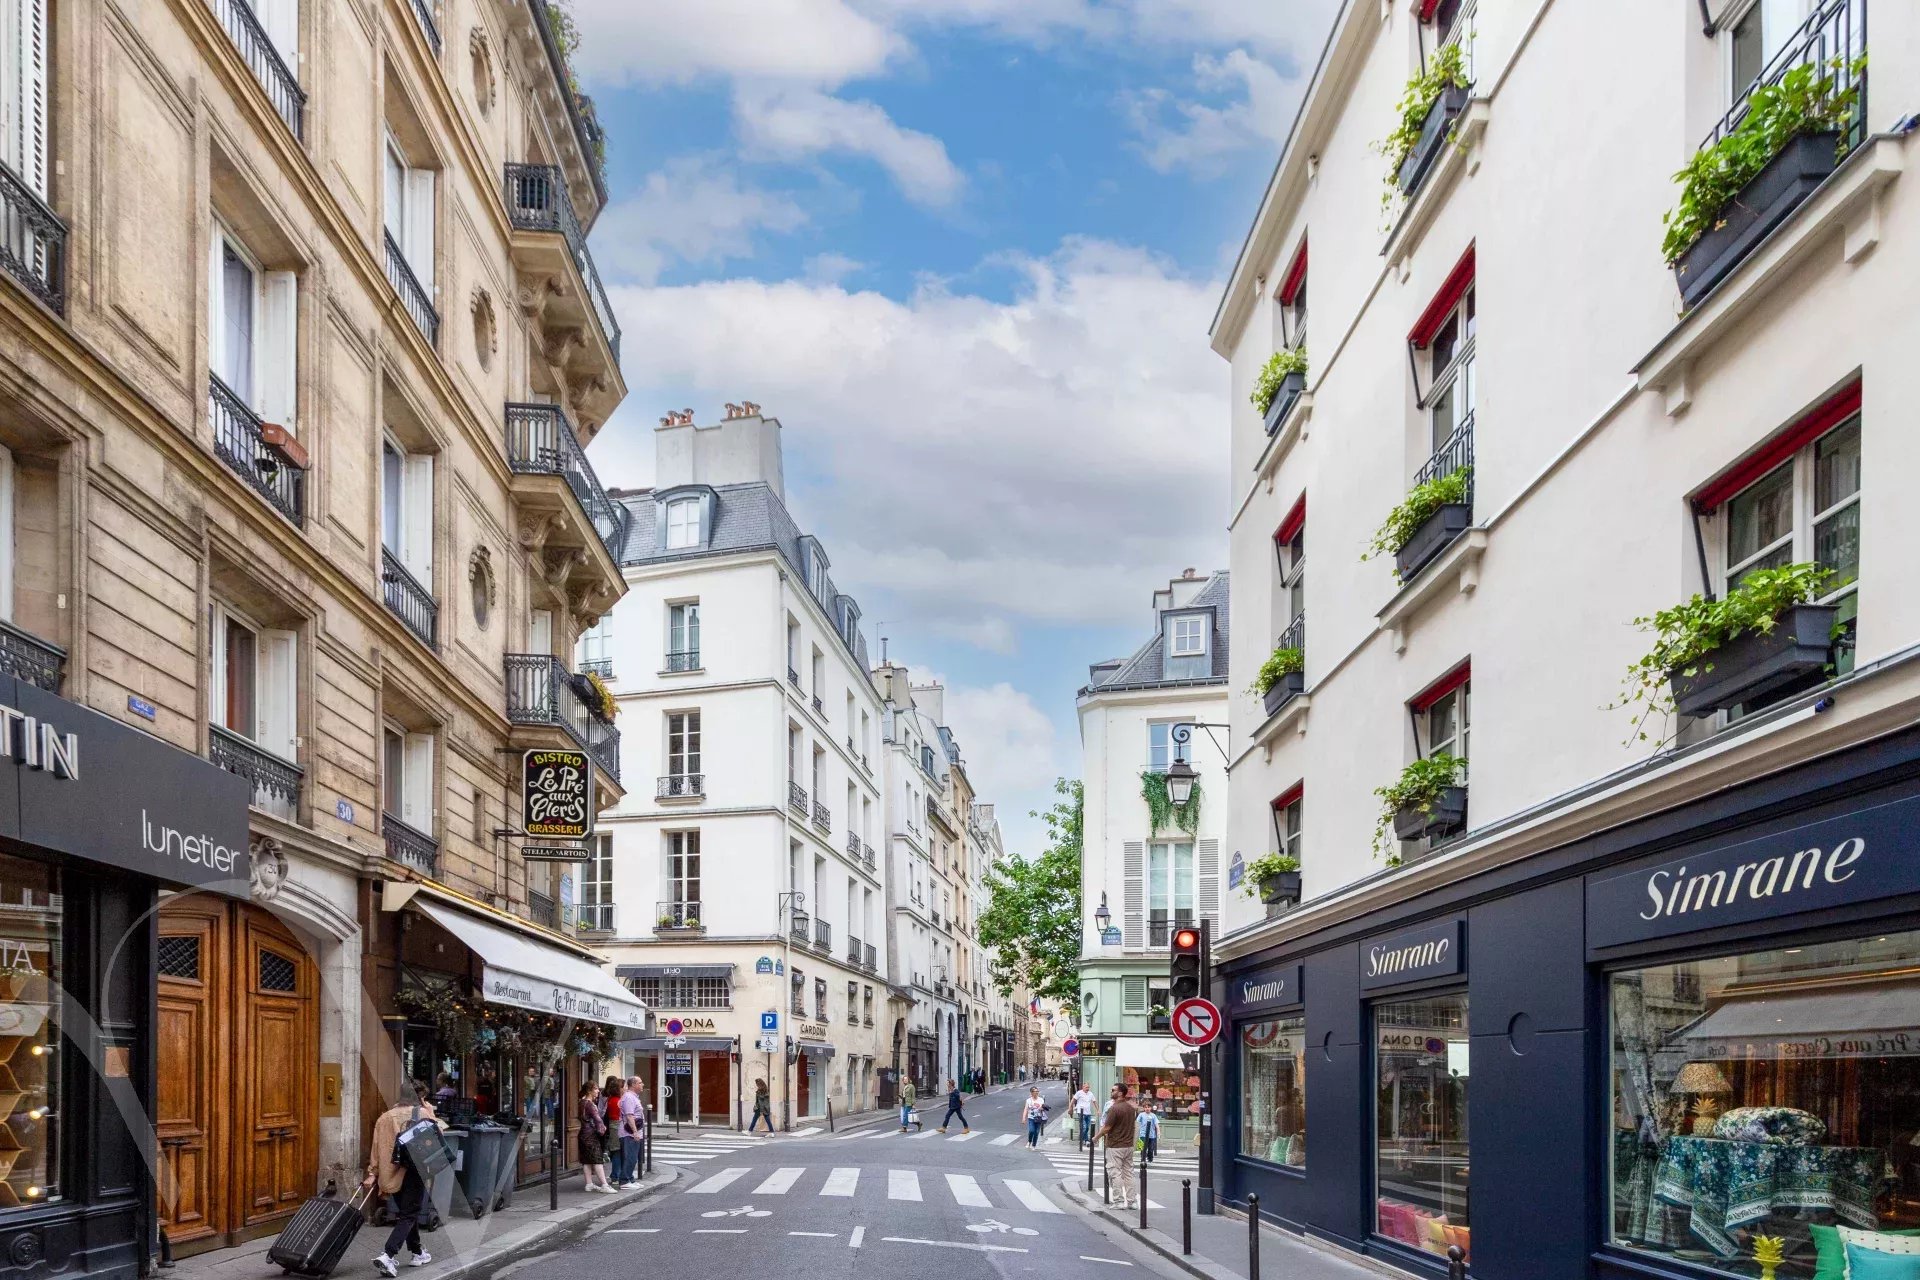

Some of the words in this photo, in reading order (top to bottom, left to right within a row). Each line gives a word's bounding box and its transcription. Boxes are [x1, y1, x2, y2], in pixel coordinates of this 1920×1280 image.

[534, 752, 582, 766] BISTRO
[528, 767, 559, 793] Le
[559, 765, 585, 794] Pré
[548, 792, 574, 803] aux
[339, 803, 351, 821] 30
[528, 823, 583, 834] BRASSERIE
[142, 808, 240, 874] lunetier
[522, 848, 549, 856] STELLA
[1639, 837, 1865, 921] Simrane
[1367, 938, 1449, 977] Simrane
[494, 981, 531, 1001] Restaurant
[1242, 979, 1284, 1004] Simrane
[552, 988, 562, 1012] Le
[564, 991, 577, 1012] Pré
[577, 1000, 592, 1015] aux
[592, 999, 610, 1018] Clercs
[765, 1015, 773, 1027] P
[800, 1023, 827, 1037] CARDONA
